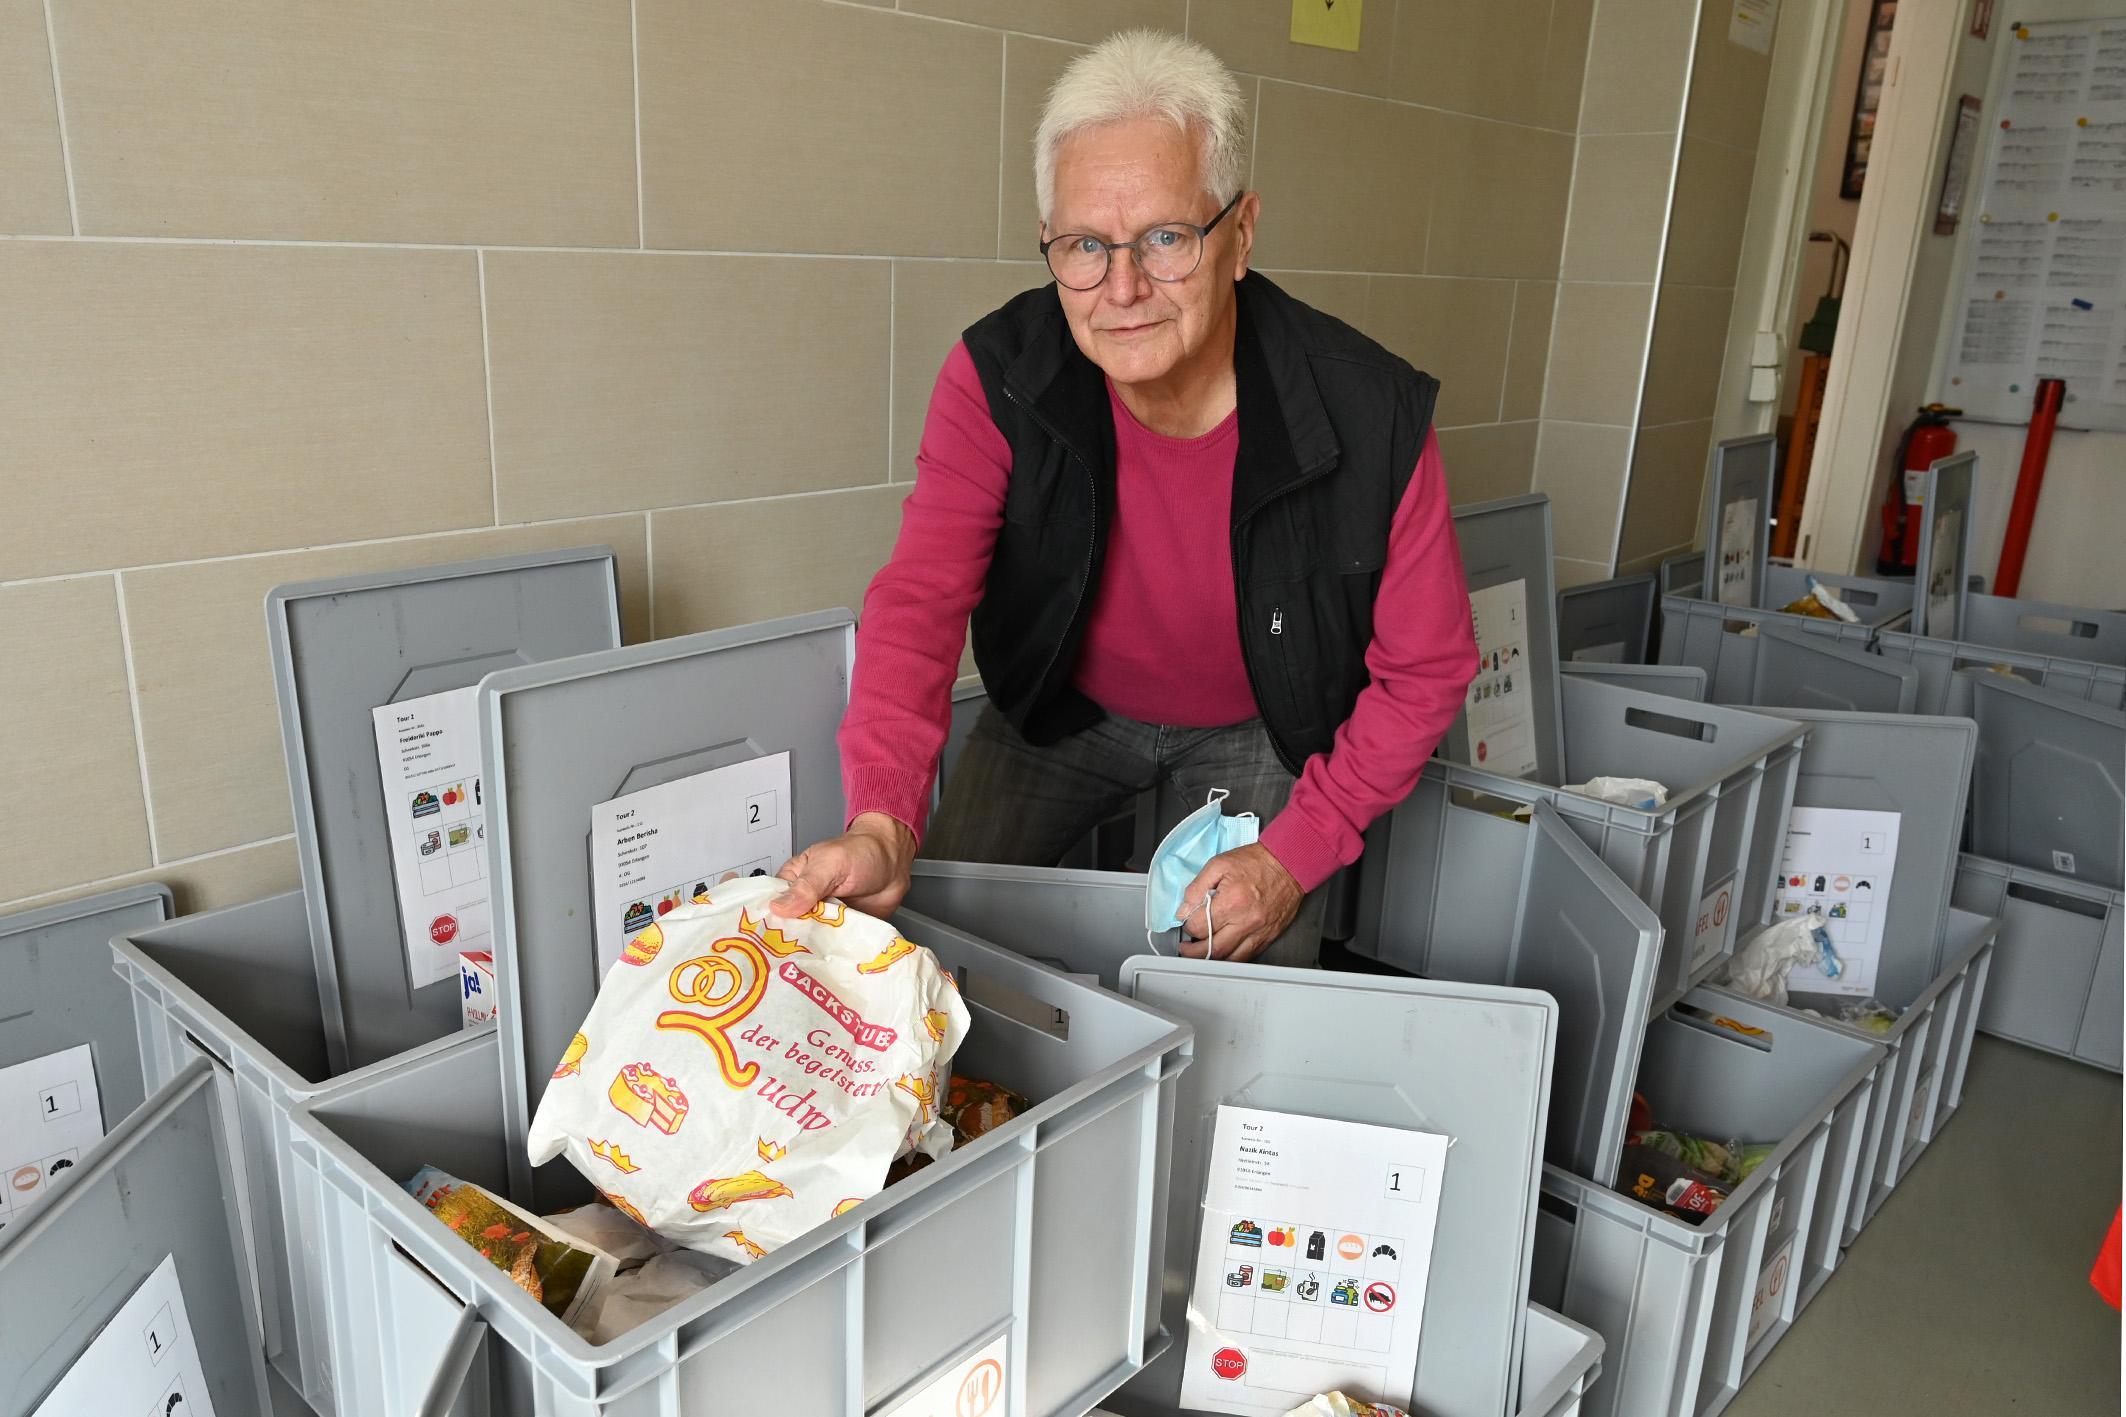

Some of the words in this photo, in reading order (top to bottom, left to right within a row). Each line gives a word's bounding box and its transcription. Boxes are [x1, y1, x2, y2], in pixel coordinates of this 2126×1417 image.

[397, 715, 410, 723] Tour
[616, 812, 630, 821] Tour
[750, 804, 760, 824] 2
[617, 834, 636, 845] Arben
[636, 828, 658, 840] Berisha
[1864, 837, 1871, 849] 1
[432, 922, 455, 937] STOP
[461, 965, 482, 999] ja!
[783, 963, 894, 1047] BACKSTUBE
[1055, 1008, 1065, 1023] 1
[740, 1023, 780, 1052] der
[45, 1095, 59, 1113] 1
[1242, 1123, 1258, 1131] Tour
[1389, 1172, 1400, 1191] 1
[149, 1330, 162, 1354] 1
[1215, 1358, 1243, 1370] STOP
